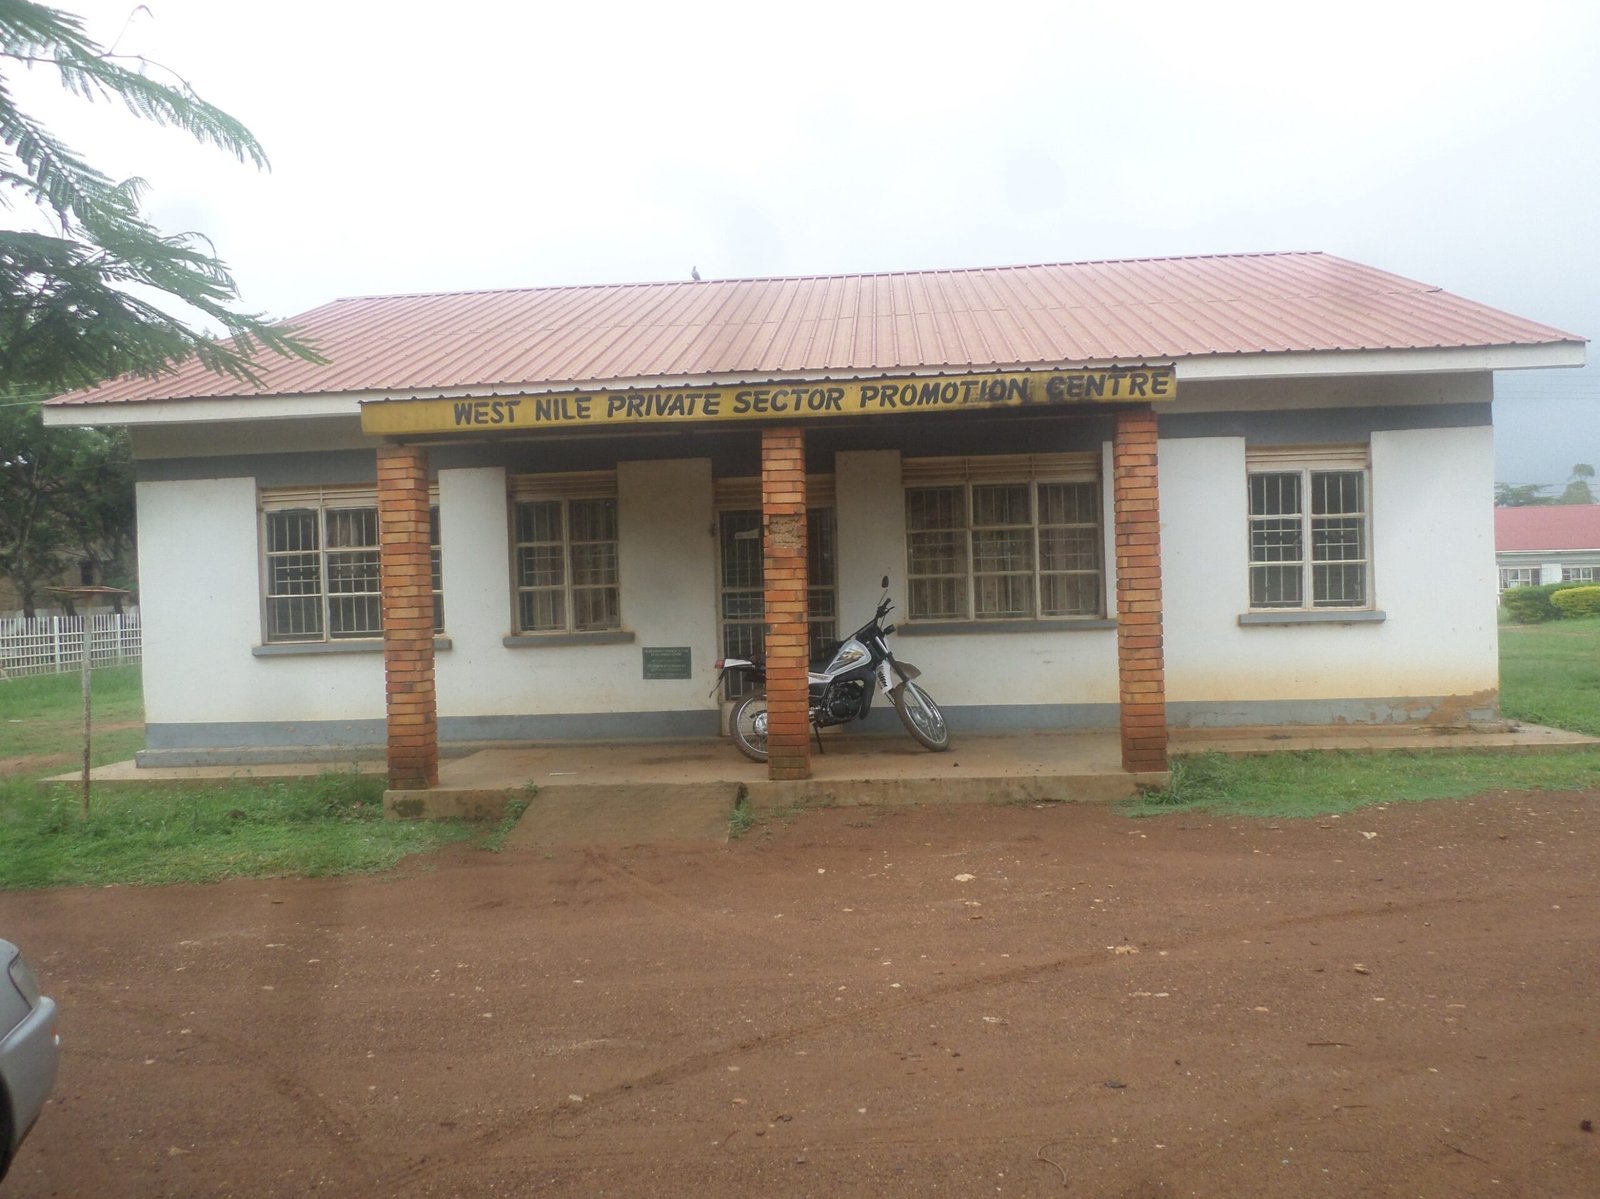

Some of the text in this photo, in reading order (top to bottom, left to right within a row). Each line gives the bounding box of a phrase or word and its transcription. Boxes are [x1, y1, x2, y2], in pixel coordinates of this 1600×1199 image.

[454, 372, 1170, 426] WEST NILE PRIVATE SECTOR PROMOTION CENTRE
